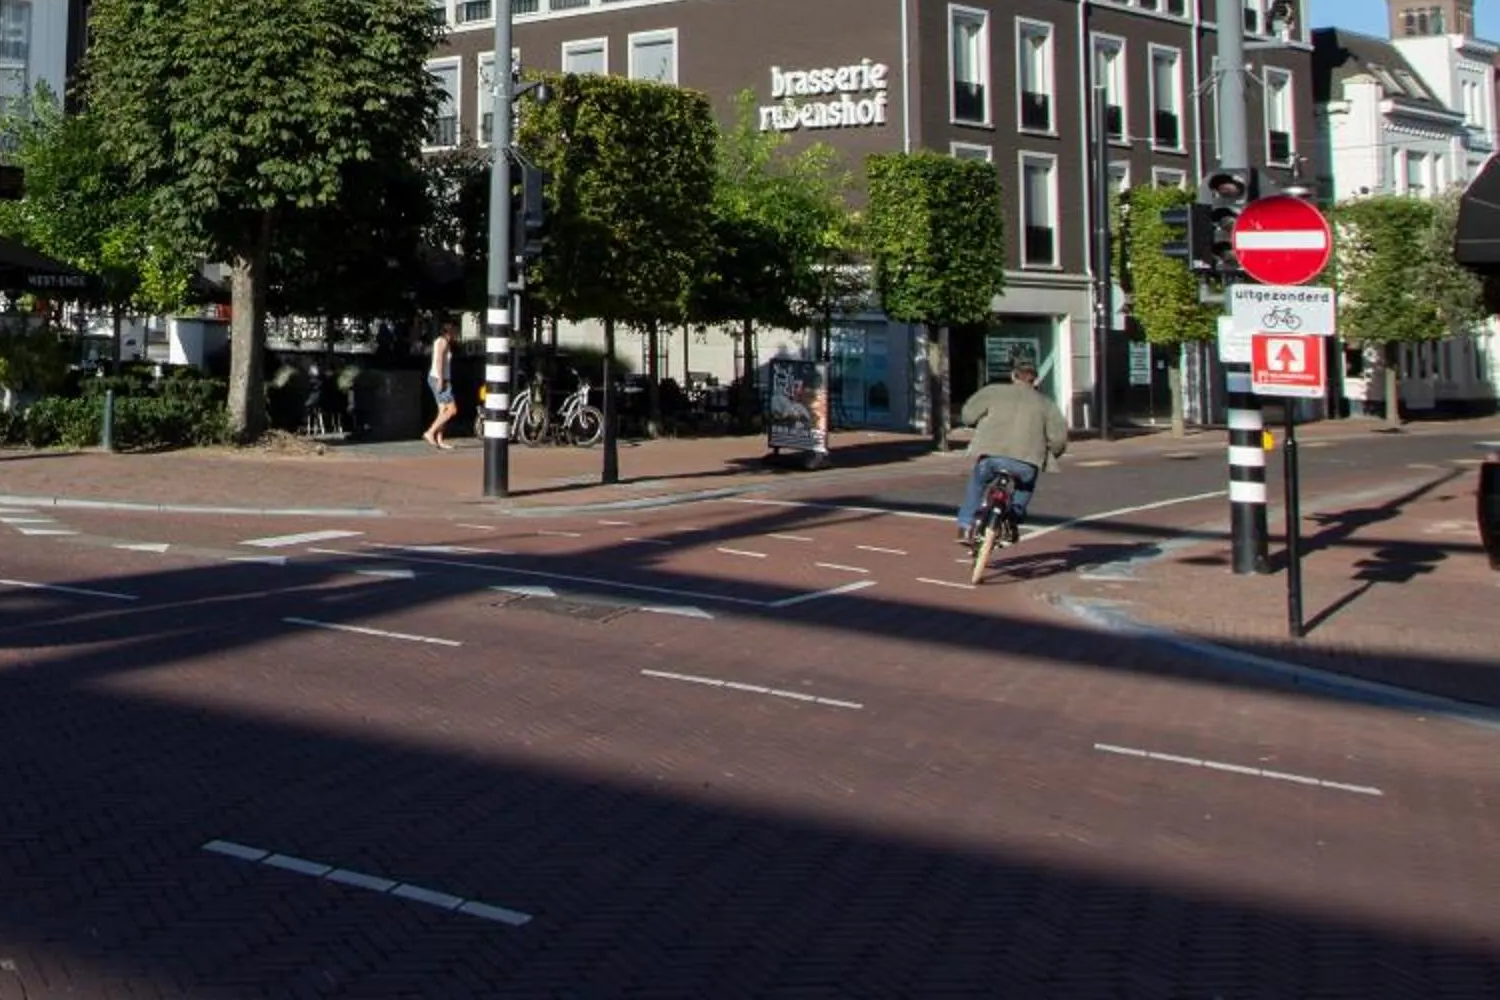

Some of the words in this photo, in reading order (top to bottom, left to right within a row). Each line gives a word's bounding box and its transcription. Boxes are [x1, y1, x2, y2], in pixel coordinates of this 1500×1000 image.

[771, 58, 889, 97] brasserie
[759, 91, 888, 130] rubenshof
[1235, 289, 1330, 303] uitgezonderd
